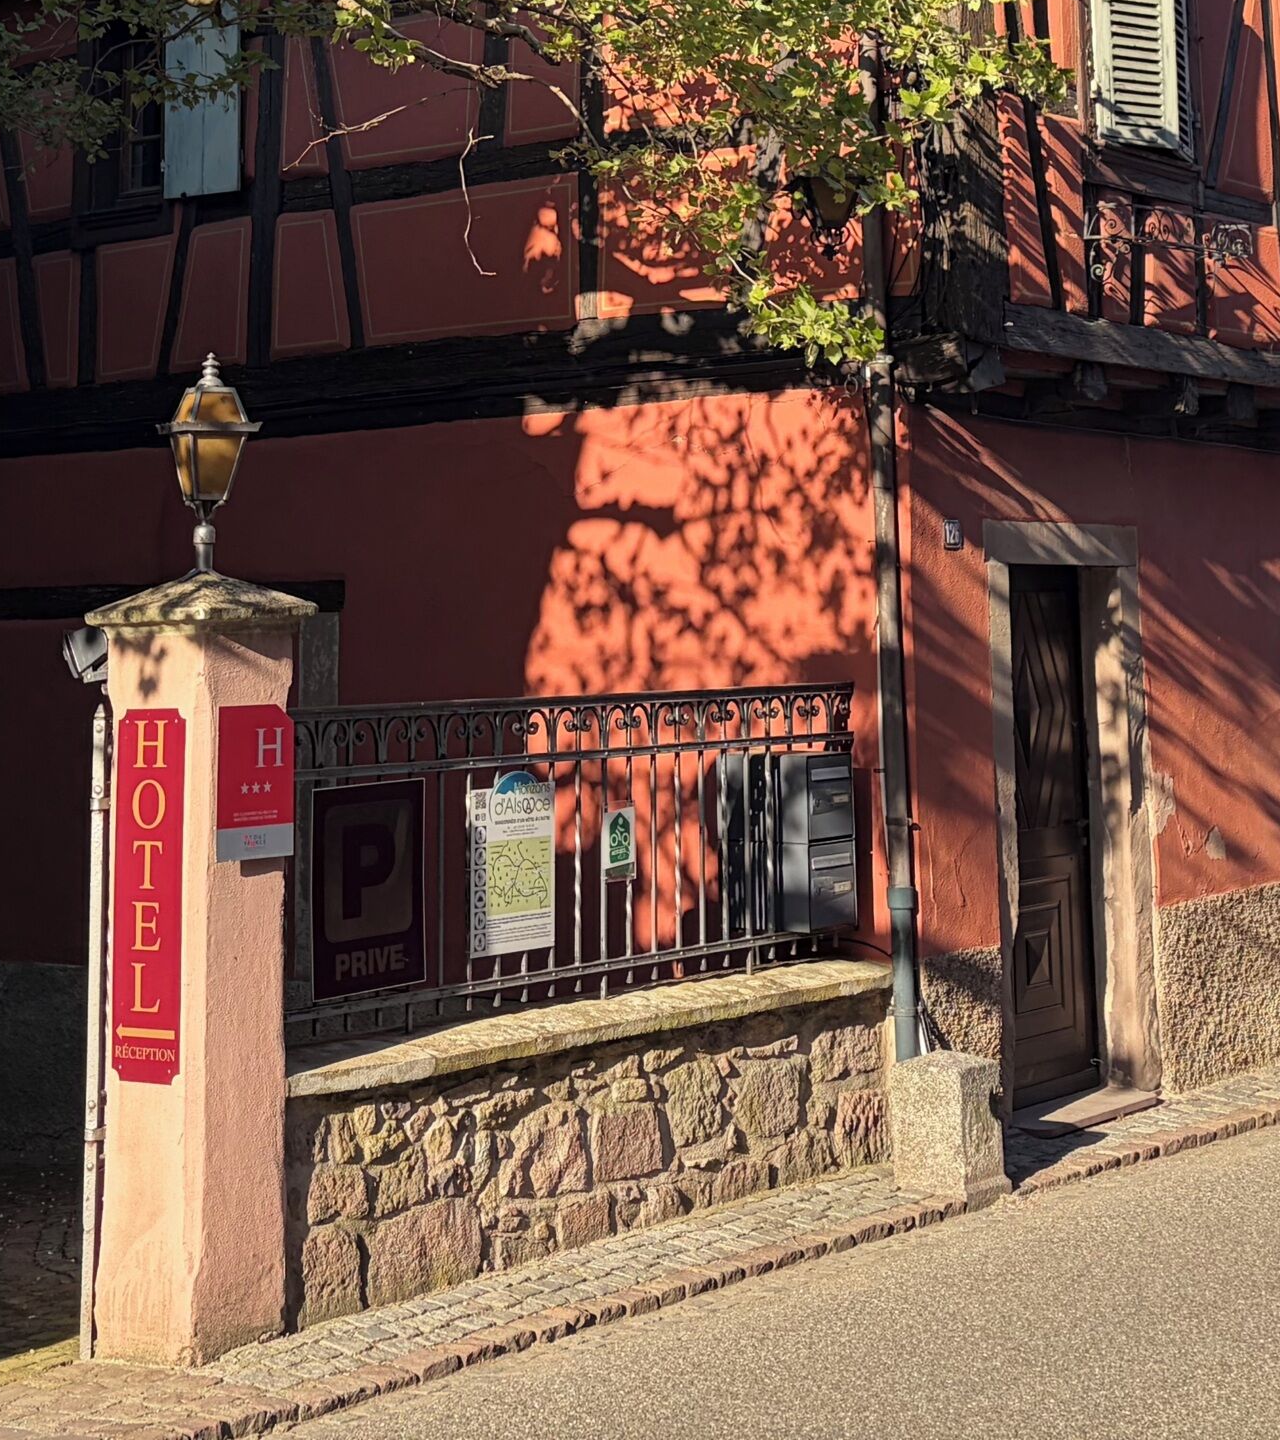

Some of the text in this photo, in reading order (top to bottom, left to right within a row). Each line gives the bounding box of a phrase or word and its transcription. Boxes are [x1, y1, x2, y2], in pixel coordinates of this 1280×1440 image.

[255, 726, 285, 768] H
[513, 781, 551, 795] Horizons
[130, 719, 169, 1013] HOTEL
[342, 823, 396, 921] P
[335, 943, 406, 981] PRIVE
[114, 1042, 176, 1062] RÉCEPTION
